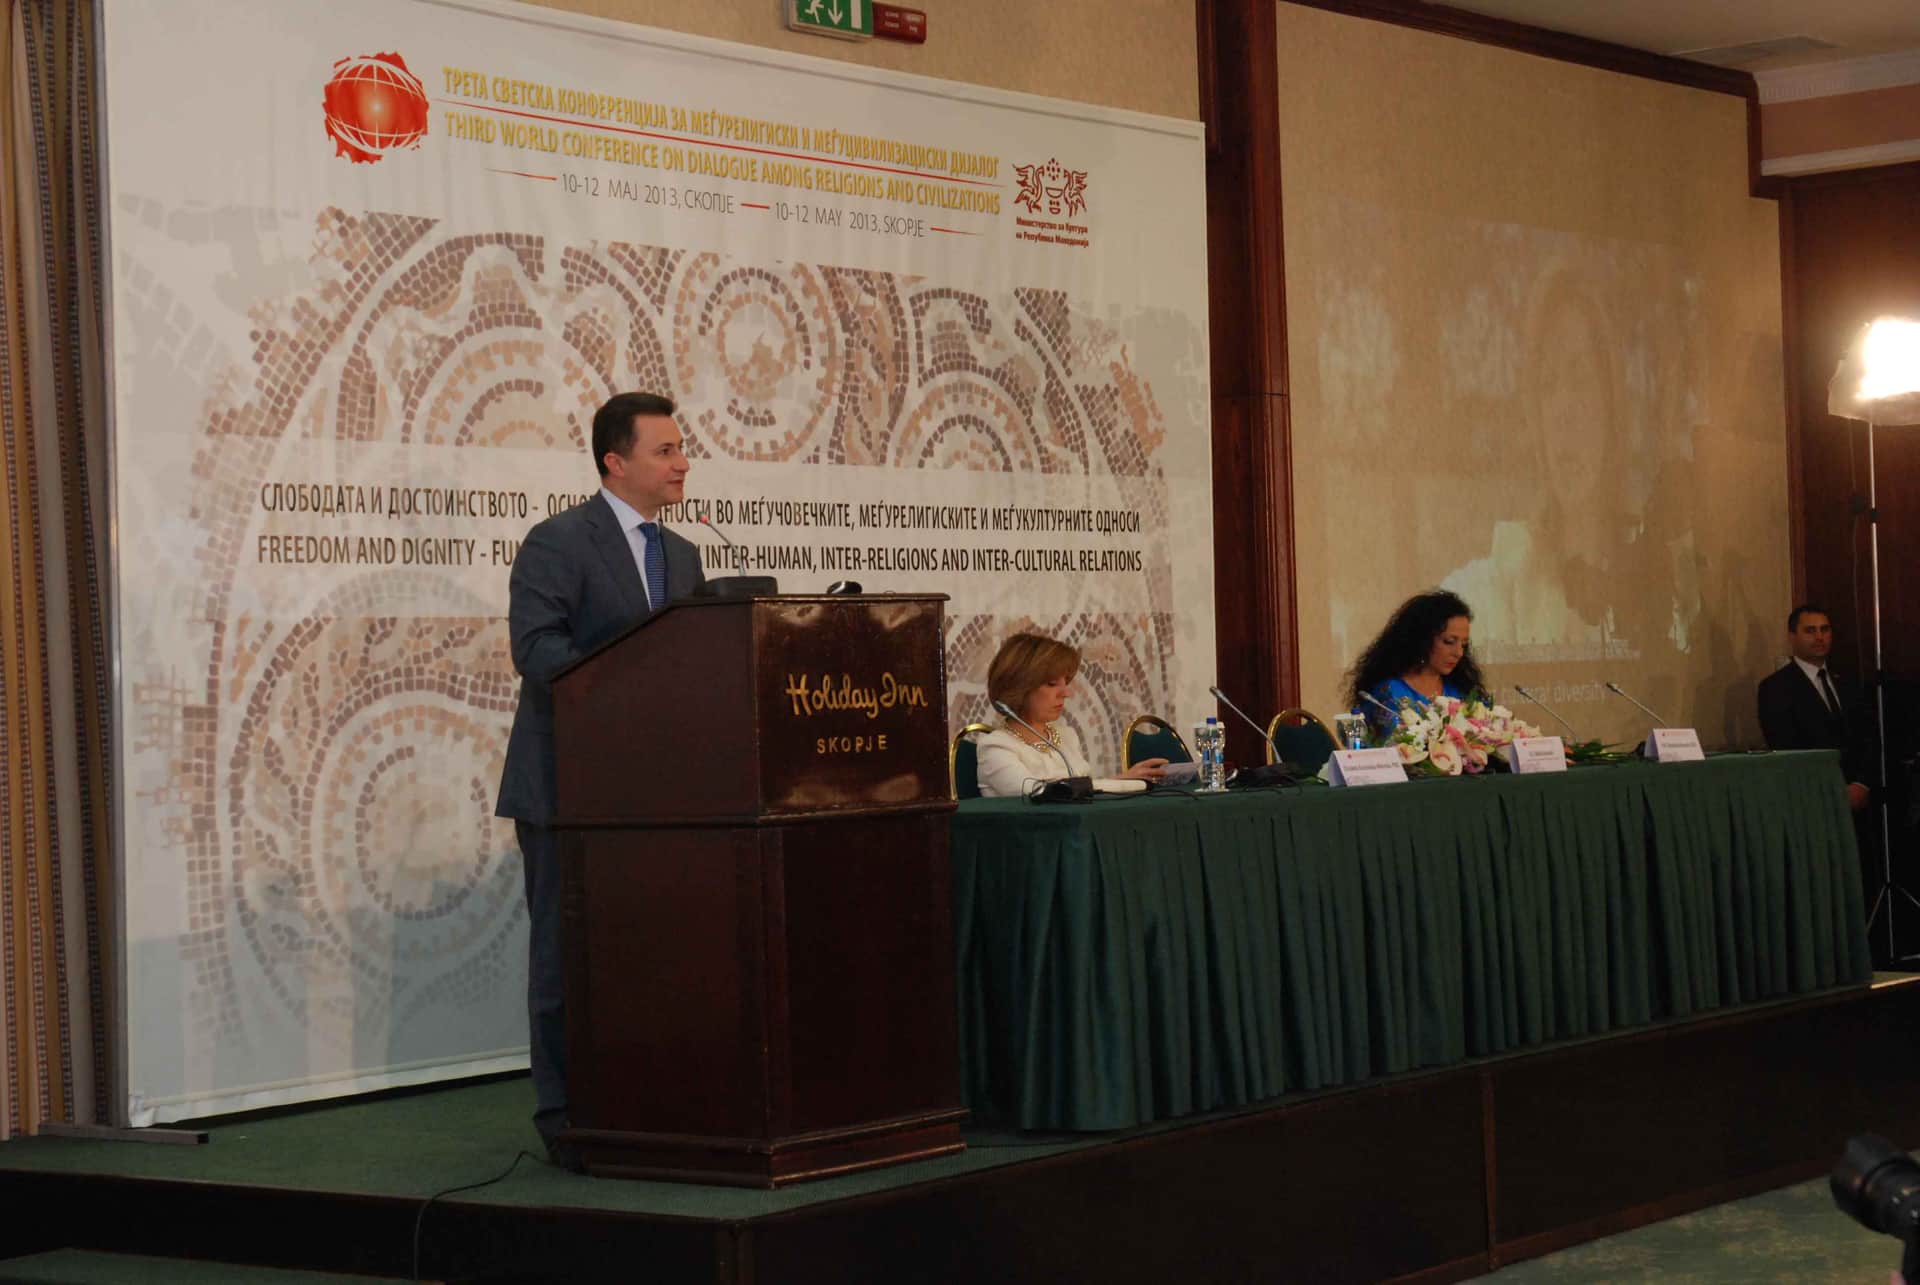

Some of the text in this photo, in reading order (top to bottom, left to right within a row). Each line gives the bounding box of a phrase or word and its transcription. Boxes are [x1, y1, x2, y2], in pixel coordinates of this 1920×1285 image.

[442, 66, 488, 100] ТРЕТА
[492, 76, 555, 112] СВЕТСКА
[558, 88, 668, 130] КОНФЕРЕНЦИЈА
[671, 106, 688, 132] ЗА
[802, 127, 811, 150] И
[951, 151, 1000, 179] ДИЈАЛОГ
[445, 111, 1001, 215] THIRD WORLD CONFERENCE ON DIALOGUE AMONG RELIGIONS AND CIVILIZATIONS
[562, 173, 600, 196] 10-12
[644, 184, 681, 210] 2013,
[775, 202, 926, 238] 10-12 MAY 2013, SKOPJE
[260, 482, 366, 518] СЛОБОДАТА
[371, 486, 382, 514] И
[388, 486, 528, 520] ДОСТОИНСТВОТО
[716, 499, 734, 524] ВО
[738, 496, 855, 531] МЕЃУЧОВЕЧКИТЕ,
[859, 499, 977, 530] МЕЃУРЕЛИГИСКИТЕ
[981, 507, 988, 530] И
[992, 504, 1093, 532] МЕЃУКУЛТУРНИТЕ
[1096, 510, 1140, 536] ОДНОСИ
[258, 535, 350, 564] FREEDOM
[356, 536, 396, 564] AND
[402, 537, 476, 565] DIGNITY
[705, 544, 817, 573] INTER-HUMAN,
[821, 545, 938, 571] INTER-RELIGIONS
[941, 548, 969, 571] AND
[972, 549, 1076, 572] INTER-CULTURAL
[1079, 550, 1142, 572] RELATIONS
[785, 671, 928, 719] Holiday Inn
[816, 734, 888, 754] SKOPJE
